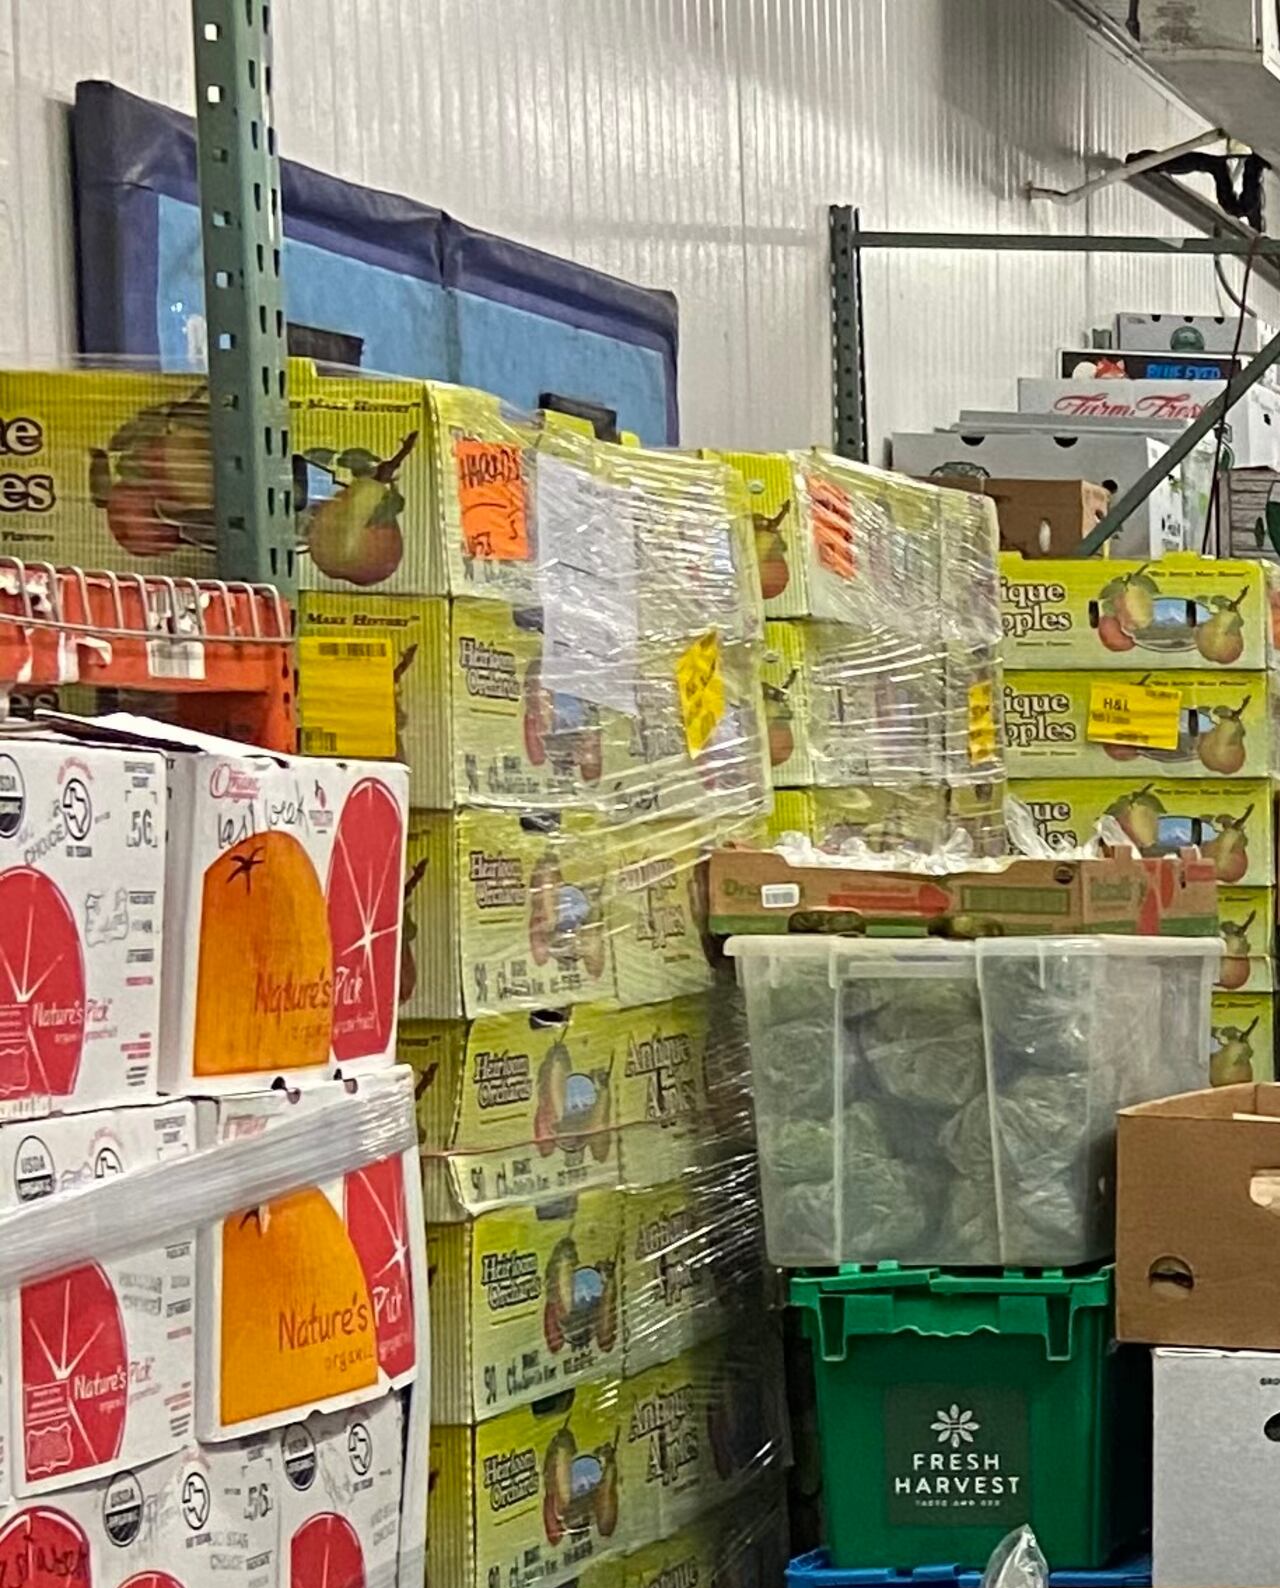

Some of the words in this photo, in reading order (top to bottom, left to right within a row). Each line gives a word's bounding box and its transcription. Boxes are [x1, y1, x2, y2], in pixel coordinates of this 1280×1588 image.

[130, 808, 153, 848] 56
[254, 966, 333, 1014] Nature's
[31, 1000, 83, 1028] Nature's
[276, 1293, 369, 1355] Nature's
[74, 1365, 127, 1399] Nature's
[913, 1453, 999, 1471] FRESH
[243, 1482, 271, 1522] 56
[895, 1476, 1020, 1494] HARVEST
